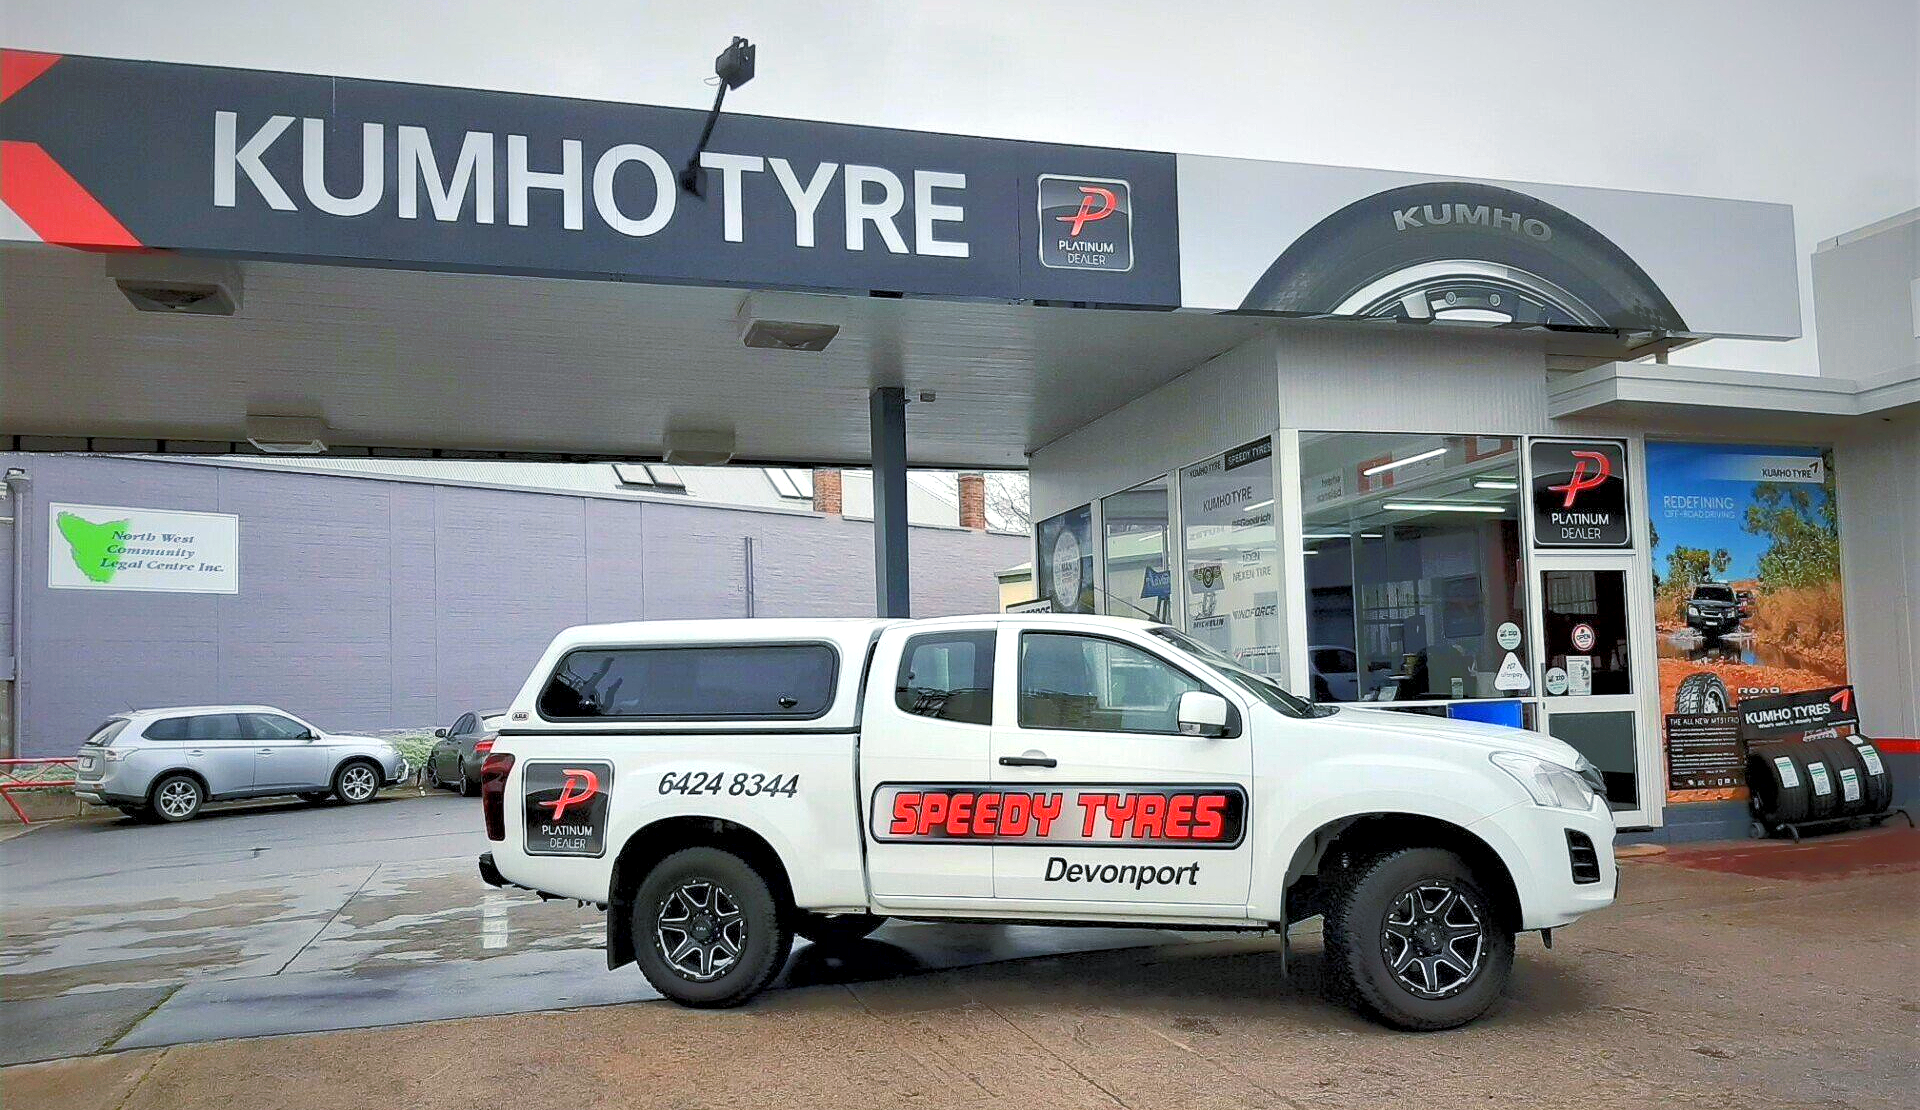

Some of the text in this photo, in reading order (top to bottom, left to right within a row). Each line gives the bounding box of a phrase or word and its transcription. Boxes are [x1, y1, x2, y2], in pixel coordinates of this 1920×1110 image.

[213, 110, 970, 258] KUMHO TYRE
[1393, 203, 1552, 242] KUMHO
[1058, 240, 1114, 254] PLATINUM
[1067, 254, 1106, 265] DEALER
[1228, 450, 1250, 466] SPEEDY
[1762, 468, 1812, 479] KUMHO TYRE
[1203, 486, 1253, 513] KUMHO TYRE
[1663, 495, 1735, 510] REDEFINING
[1550, 512, 1610, 526] PLATINUM
[111, 530, 195, 544] North West
[1561, 527, 1602, 540] DEALER
[106, 544, 196, 559] Community
[100, 557, 225, 573] Legal Centre Inc.
[1737, 687, 1780, 695] ROAD
[1744, 702, 1832, 725] KUMHO TYRES
[658, 771, 801, 798] 6424 8344
[888, 791, 1227, 839] SPEEDY TYRES
[541, 824, 593, 837] PLATINUM
[549, 837, 586, 849] DEALER
[1044, 856, 1201, 890] Devonport
